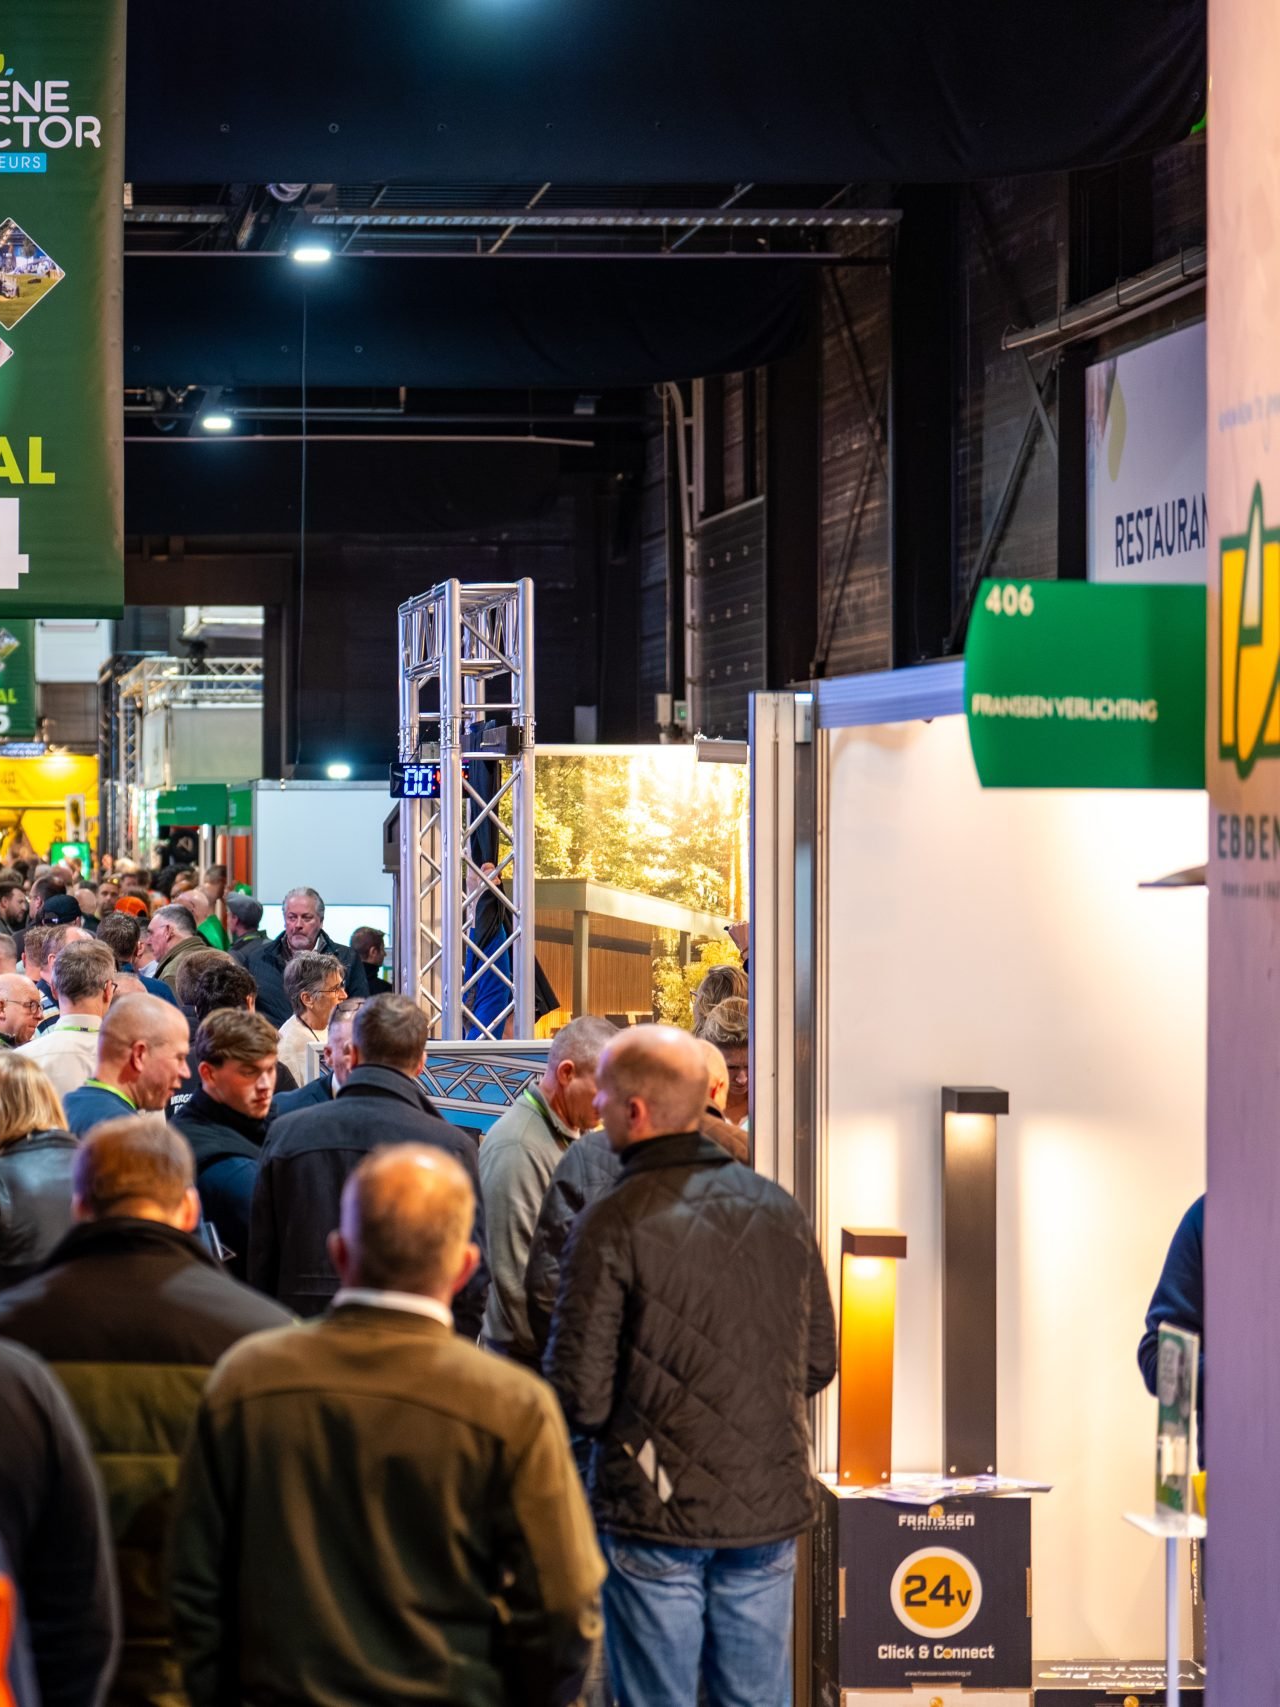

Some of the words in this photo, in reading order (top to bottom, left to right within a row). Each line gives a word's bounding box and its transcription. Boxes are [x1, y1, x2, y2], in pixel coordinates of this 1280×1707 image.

[985, 584, 1035, 617] 406
[972, 693, 1053, 719] FRANSSEN
[1055, 696, 1158, 723] VERLICHTING
[877, 1644, 915, 1660] Click
[919, 1645, 930, 1660] &
[933, 1644, 995, 1660] Connect
